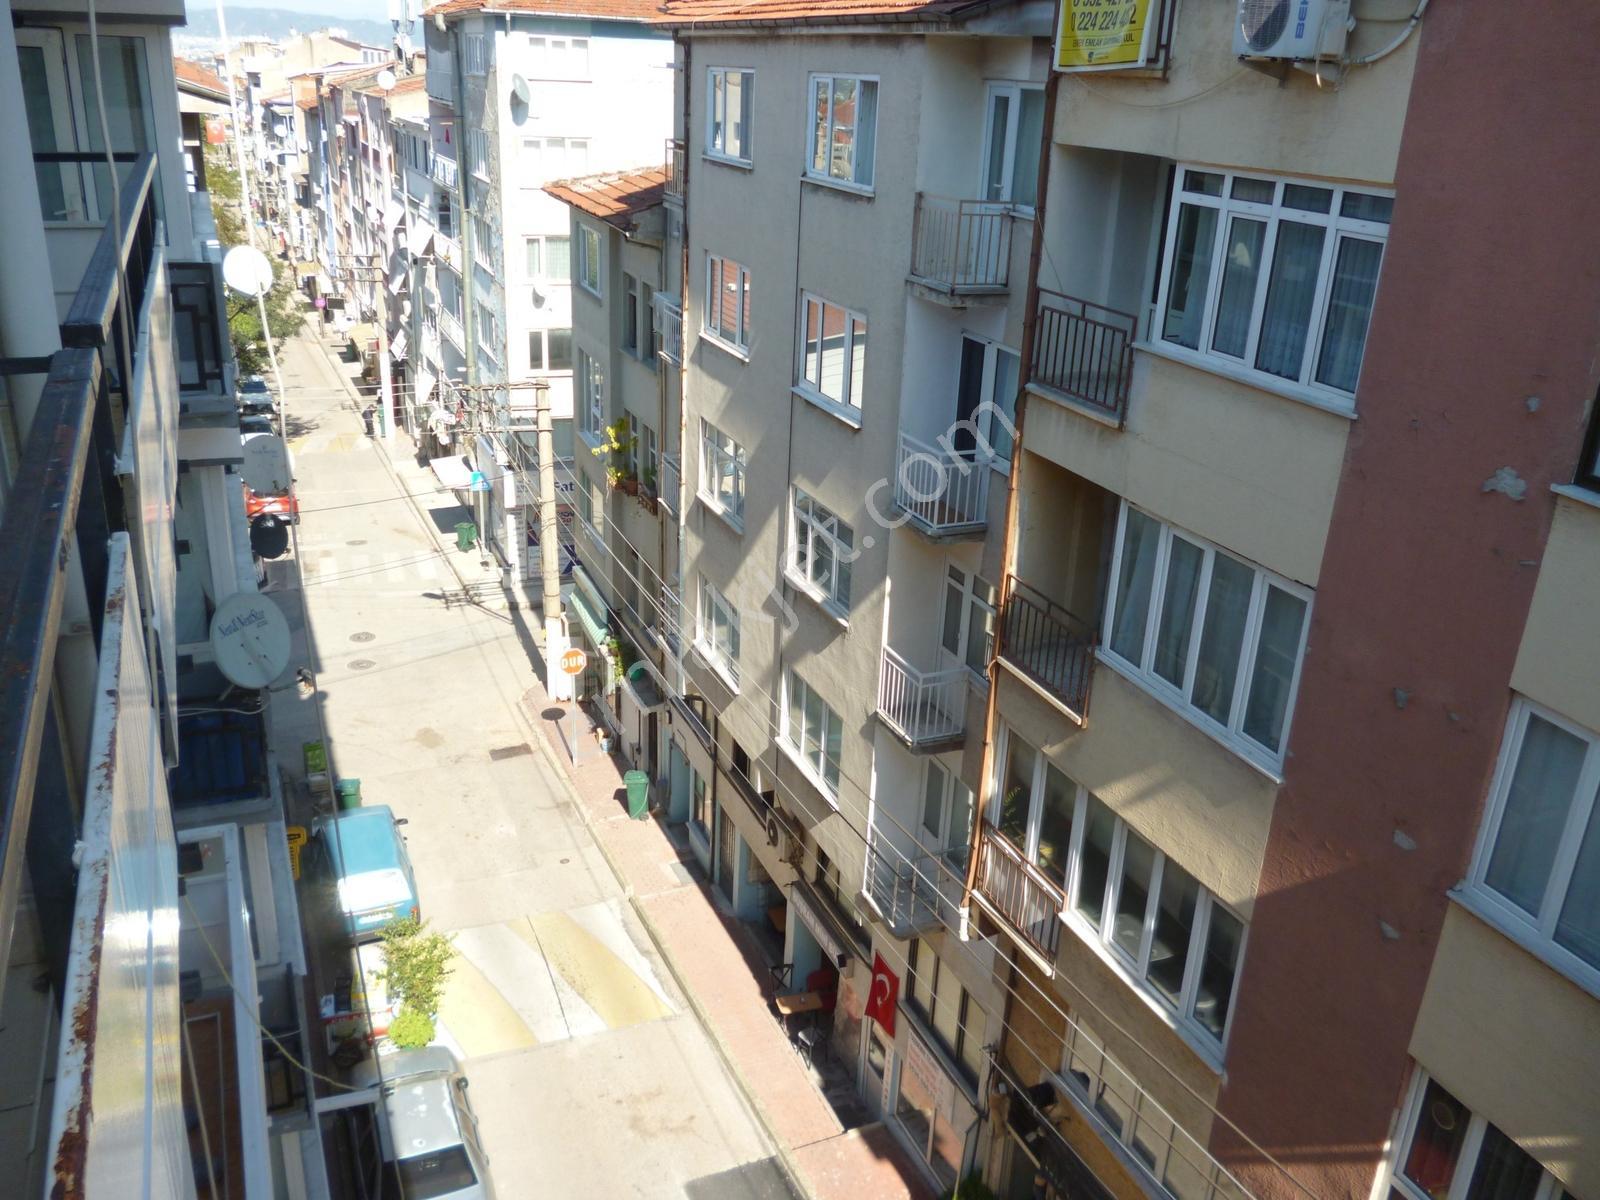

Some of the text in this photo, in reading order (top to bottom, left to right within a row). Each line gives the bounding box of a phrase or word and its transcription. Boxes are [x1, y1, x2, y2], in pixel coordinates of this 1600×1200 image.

[1077, 11, 1098, 31] 224
[1098, 10, 1119, 30] 224
[561, 655, 585, 669] DUR
